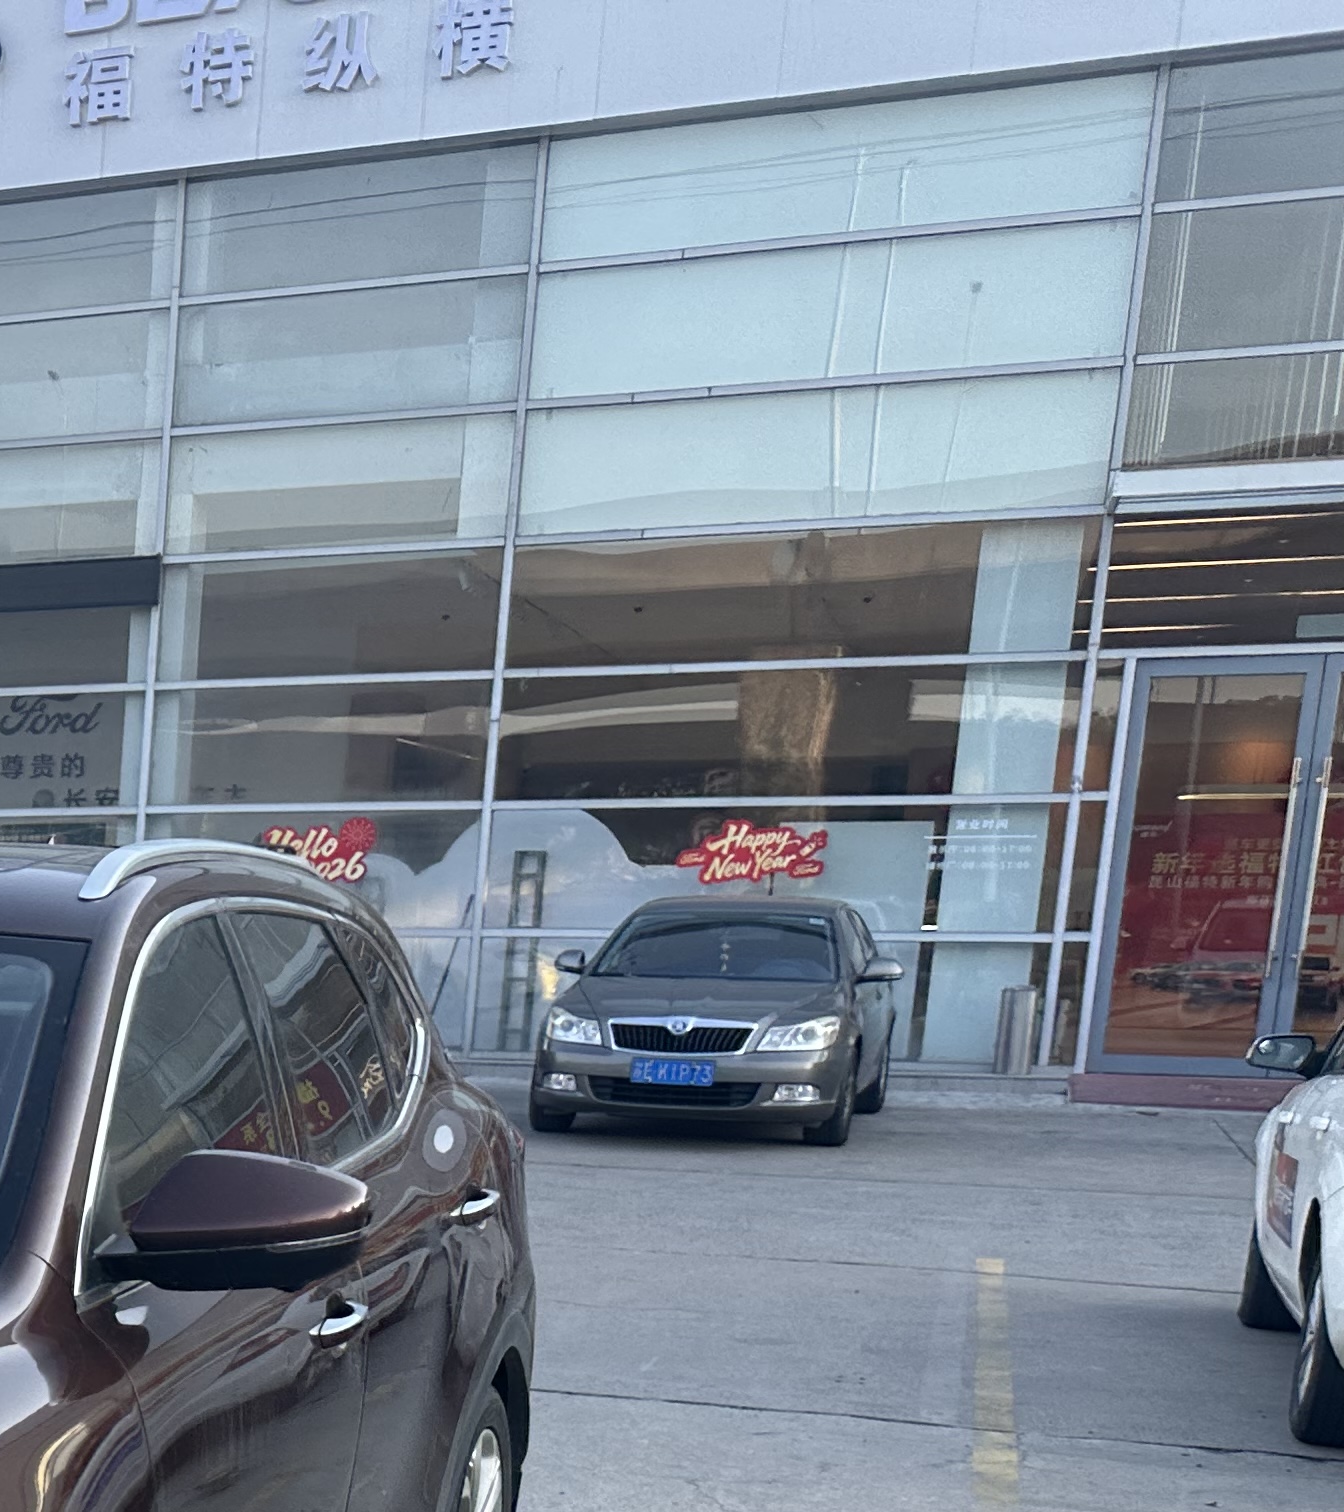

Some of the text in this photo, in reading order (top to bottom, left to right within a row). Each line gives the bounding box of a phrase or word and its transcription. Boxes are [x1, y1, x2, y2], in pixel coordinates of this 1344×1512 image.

[62, 0, 515, 127] 福特纵横
[267, 827, 339, 860] Hello
[706, 823, 802, 857] Happy
[314, 852, 366, 882] 026
[703, 847, 798, 881] New Year
